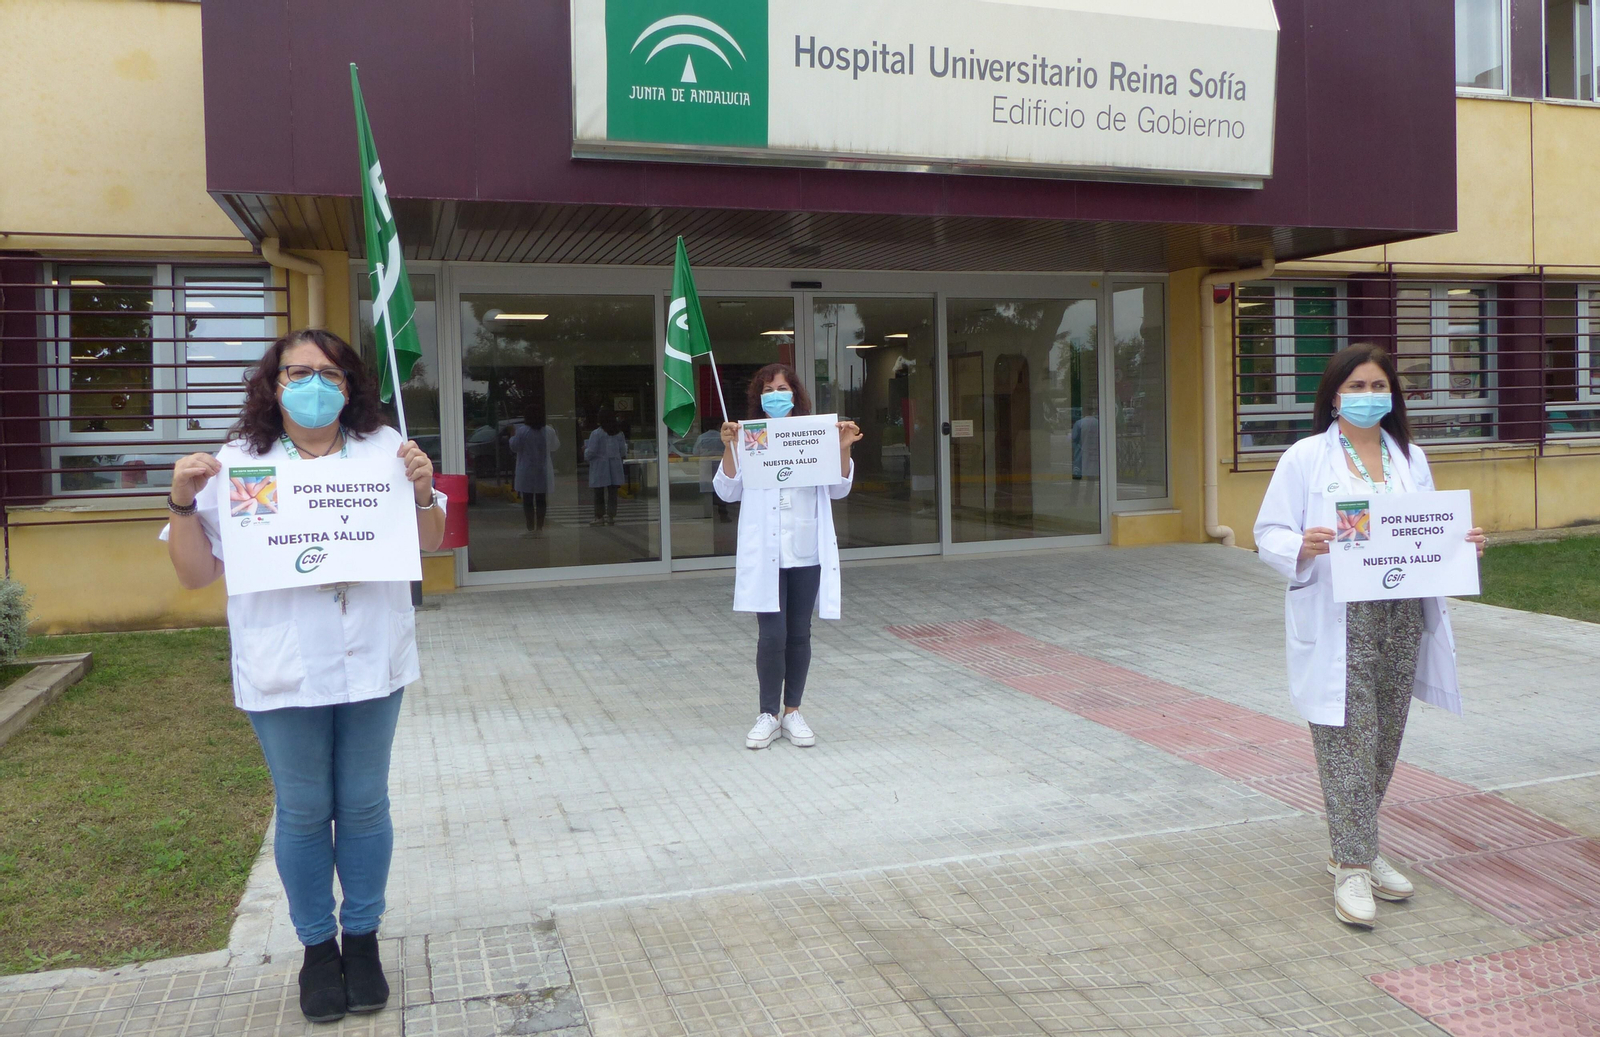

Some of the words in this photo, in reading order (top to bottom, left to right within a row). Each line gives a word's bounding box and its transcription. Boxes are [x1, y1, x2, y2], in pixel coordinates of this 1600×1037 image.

[795, 34, 914, 80] Hospital
[929, 45, 1098, 89] Universitario
[1109, 61, 1177, 96] Reina
[1188, 68, 1246, 101] Sofía
[629, 86, 665, 101] JUNTA
[671, 88, 685, 102] DE
[690, 89, 750, 106] ANDALUCIA
[992, 95, 1085, 129] Edificio
[1096, 104, 1126, 131] de
[1137, 105, 1245, 139] Gobierno
[775, 431, 791, 439] POR
[791, 429, 826, 438] NUESTROS
[782, 439, 819, 447] DERECHOS
[763, 459, 794, 467] NUESTRA
[795, 457, 817, 465] SALUD
[293, 484, 322, 494] POR
[326, 483, 391, 493] NUESTROS
[309, 498, 378, 509] DERECHOS
[340, 515, 349, 524] Y
[1381, 516, 1402, 525] POR
[1405, 513, 1454, 523] NUESTROS
[1392, 526, 1444, 537] DERECHOS
[268, 532, 330, 546] NUESTRA
[334, 531, 375, 541] SALUD
[1415, 541, 1422, 550] Y
[1363, 557, 1407, 567] NUESTRA
[1410, 554, 1442, 563] SALUD
